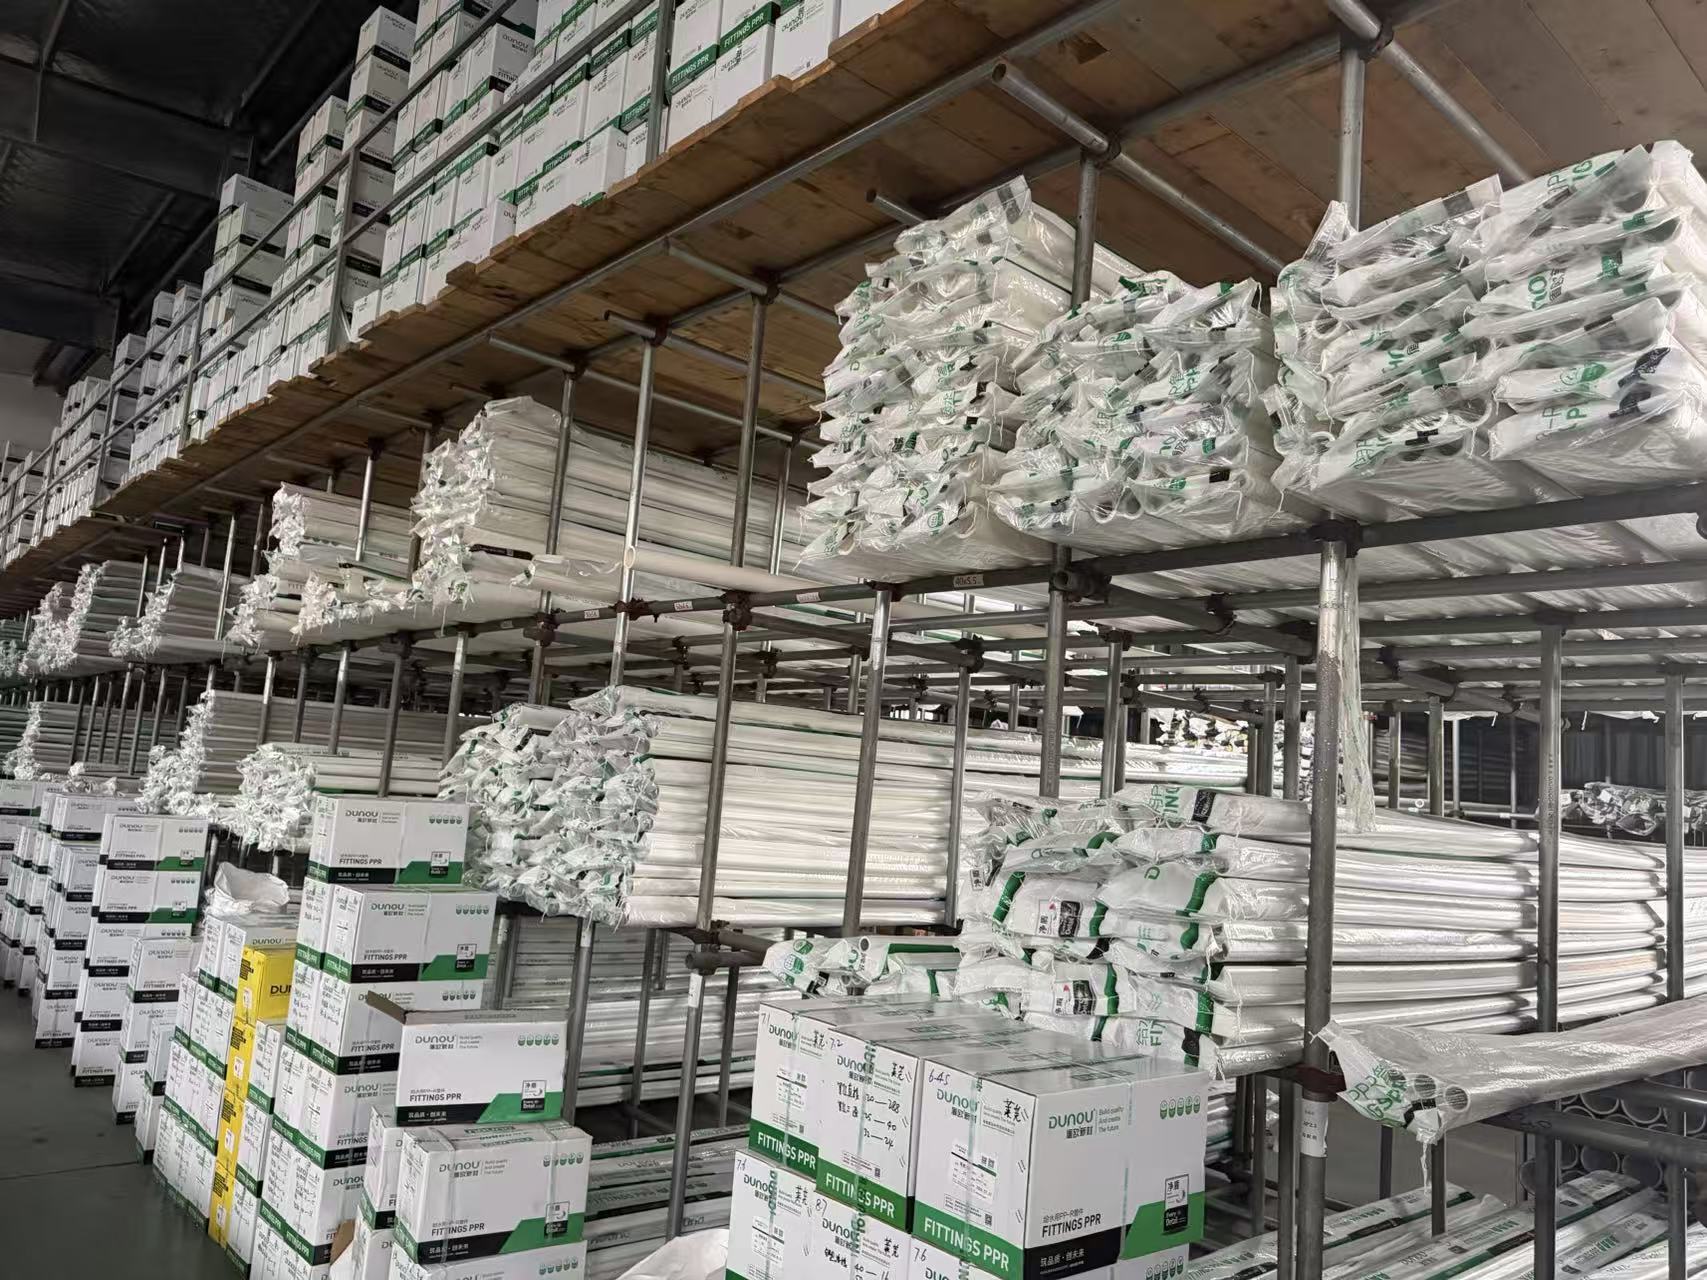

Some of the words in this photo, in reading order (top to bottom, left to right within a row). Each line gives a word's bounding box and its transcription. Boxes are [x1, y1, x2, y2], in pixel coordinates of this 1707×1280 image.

[724, 21, 751, 48] FITTINGS
[751, 13, 764, 28] PPR
[672, 62, 697, 84] FITTINGS
[697, 54, 709, 67] PPR
[351, 1044, 380, 1052] FITTINGS
[416, 1035, 455, 1043] DUNOU
[344, 1084, 378, 1093] DUNOU
[409, 1094, 445, 1102] FITTINGS
[937, 1089, 978, 1113] DUNOU
[1049, 1111, 1094, 1129] DUNOU
[757, 1131, 796, 1159] FITTINGS
[797, 1147, 816, 1170] PPR
[439, 1162, 480, 1172] DUNOU
[872, 1196, 895, 1219] PPR
[431, 1224, 467, 1236] FITTINGS
[469, 1223, 485, 1231] PPR
[1042, 1217, 1083, 1238] FITTINGS
[1084, 1213, 1101, 1228] PPR
[924, 1217, 981, 1257] FITTINGS
[983, 1244, 1010, 1270] PPR
